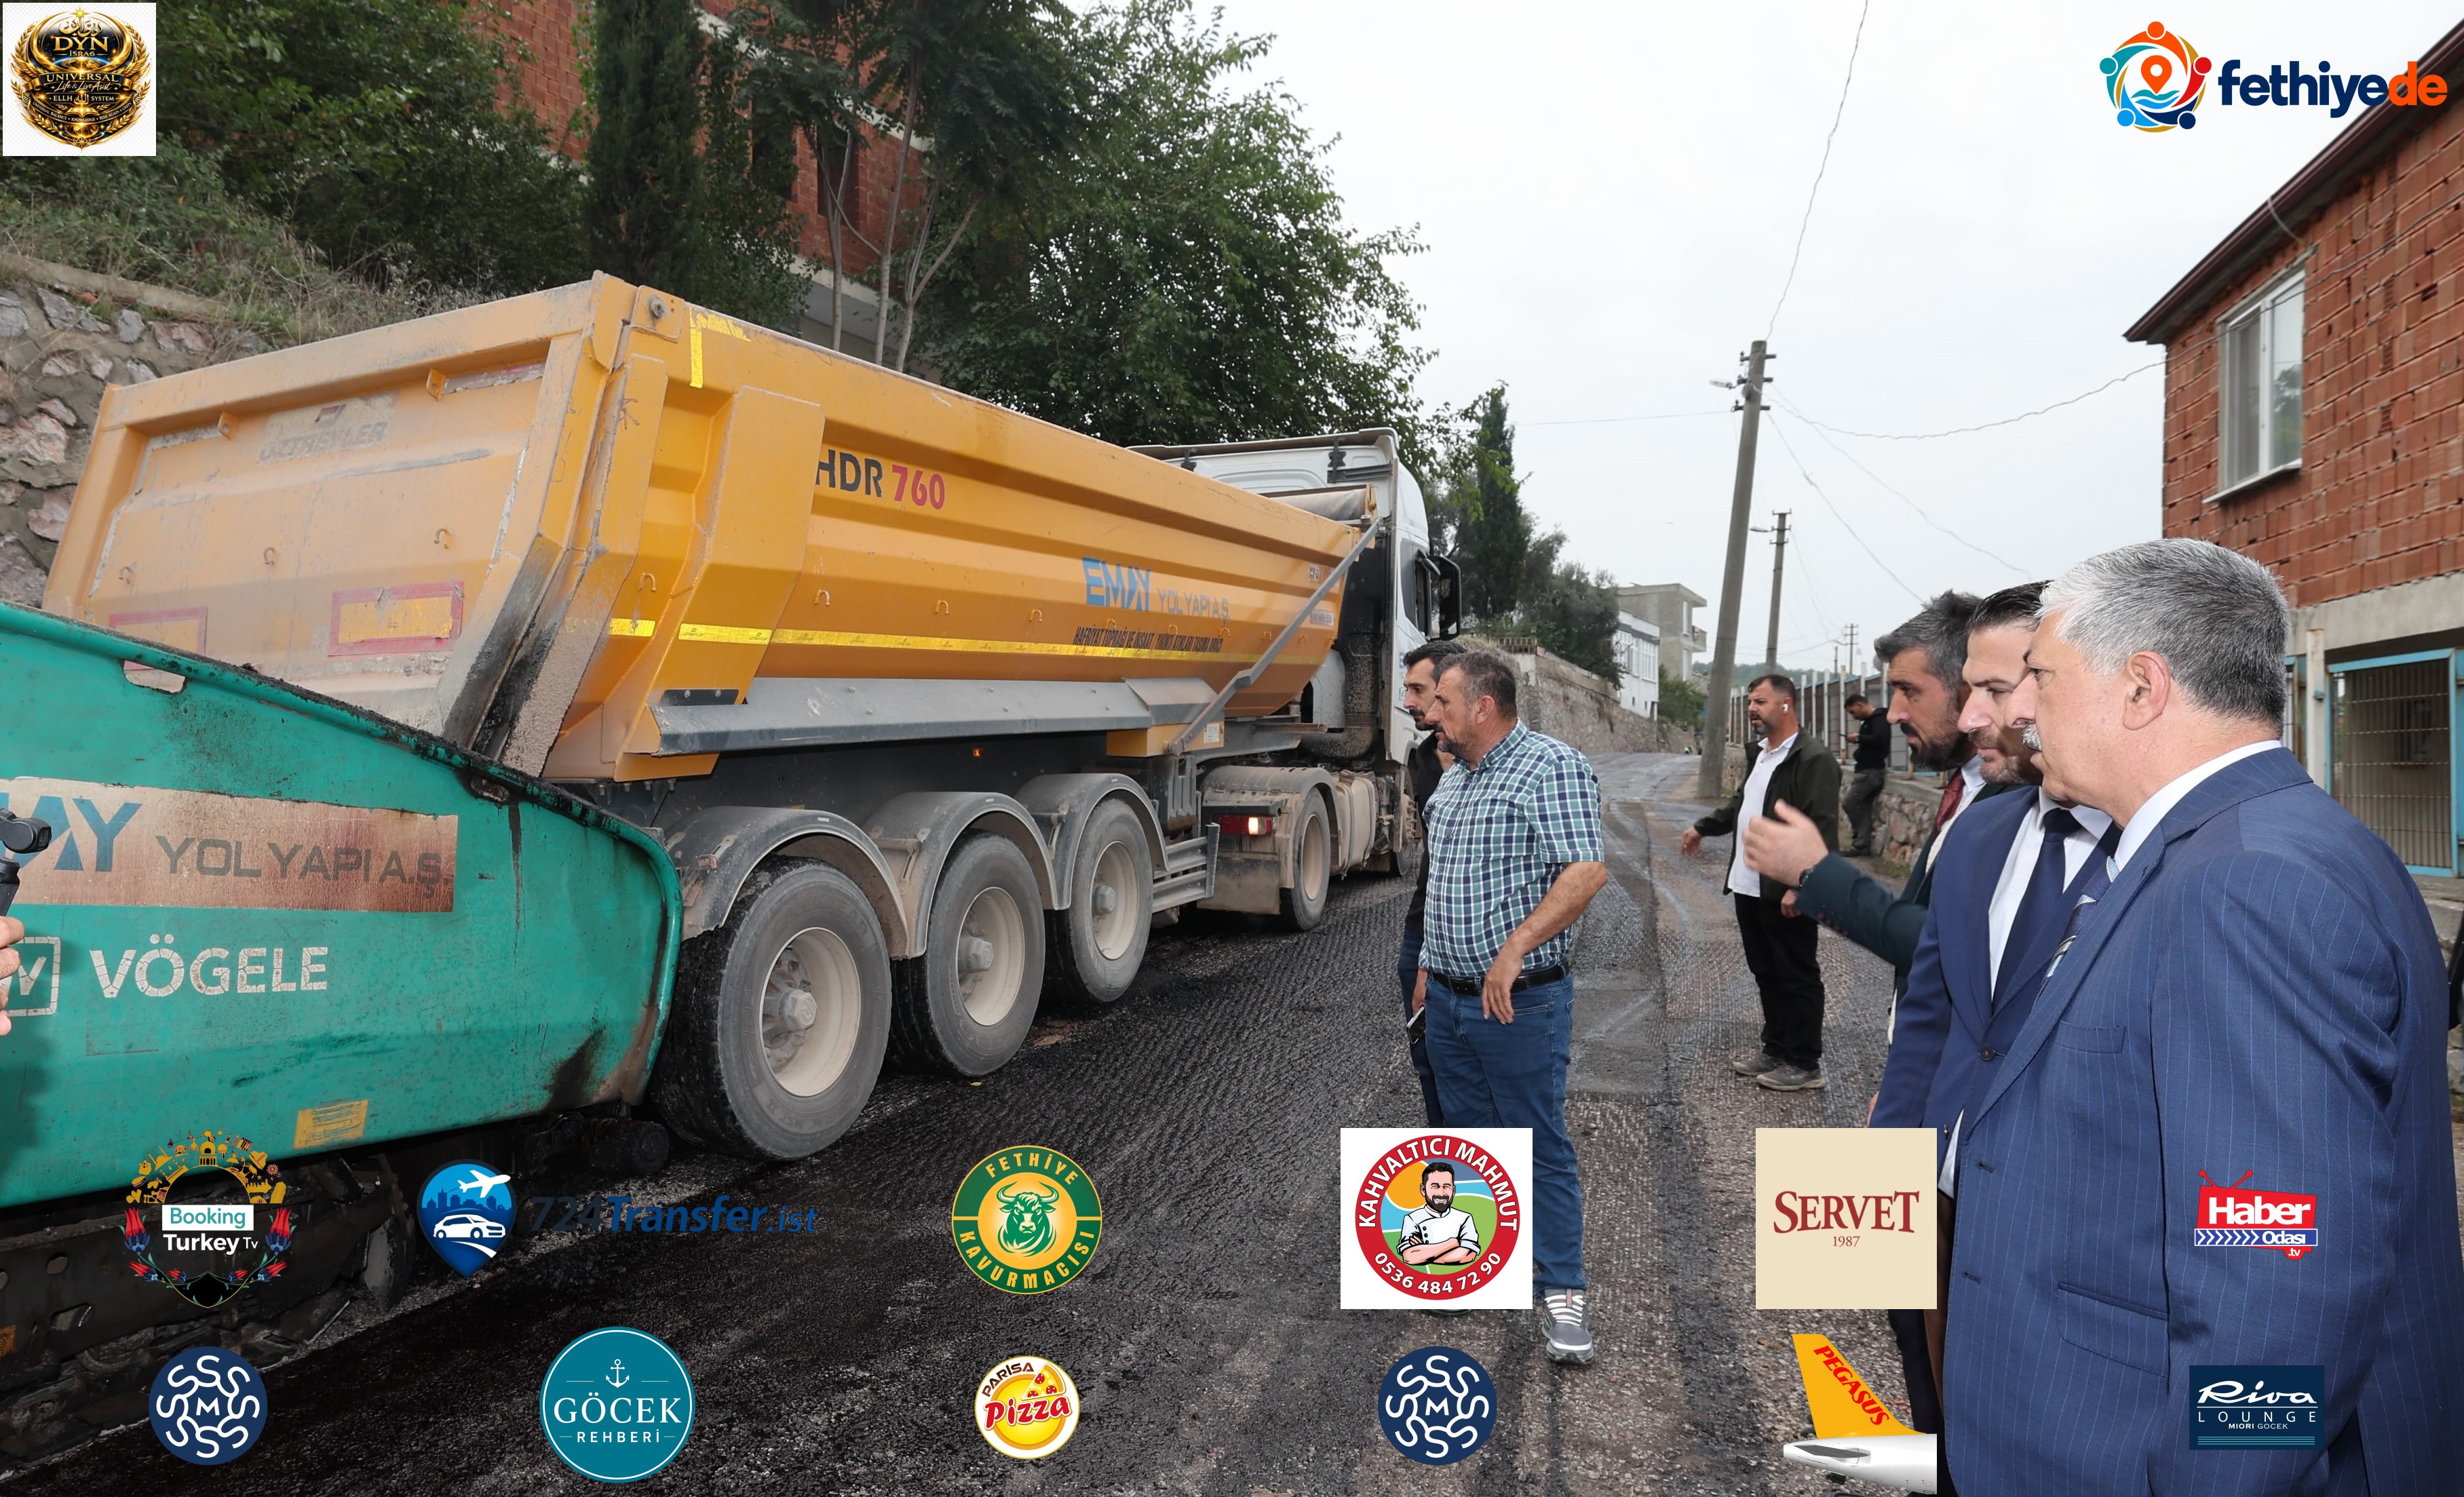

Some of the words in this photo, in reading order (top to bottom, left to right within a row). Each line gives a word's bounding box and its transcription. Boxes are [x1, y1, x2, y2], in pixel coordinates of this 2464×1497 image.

[815, 449, 883, 498] HDR
[892, 464, 945, 509] 760
[1082, 557, 1151, 613] EMAY
[1156, 587, 1184, 615] YOL
[1184, 591, 1210, 618] YAPI
[155, 835, 262, 878] YOL
[268, 842, 371, 882] YAPI
[91, 933, 328, 998] VÖGELE
